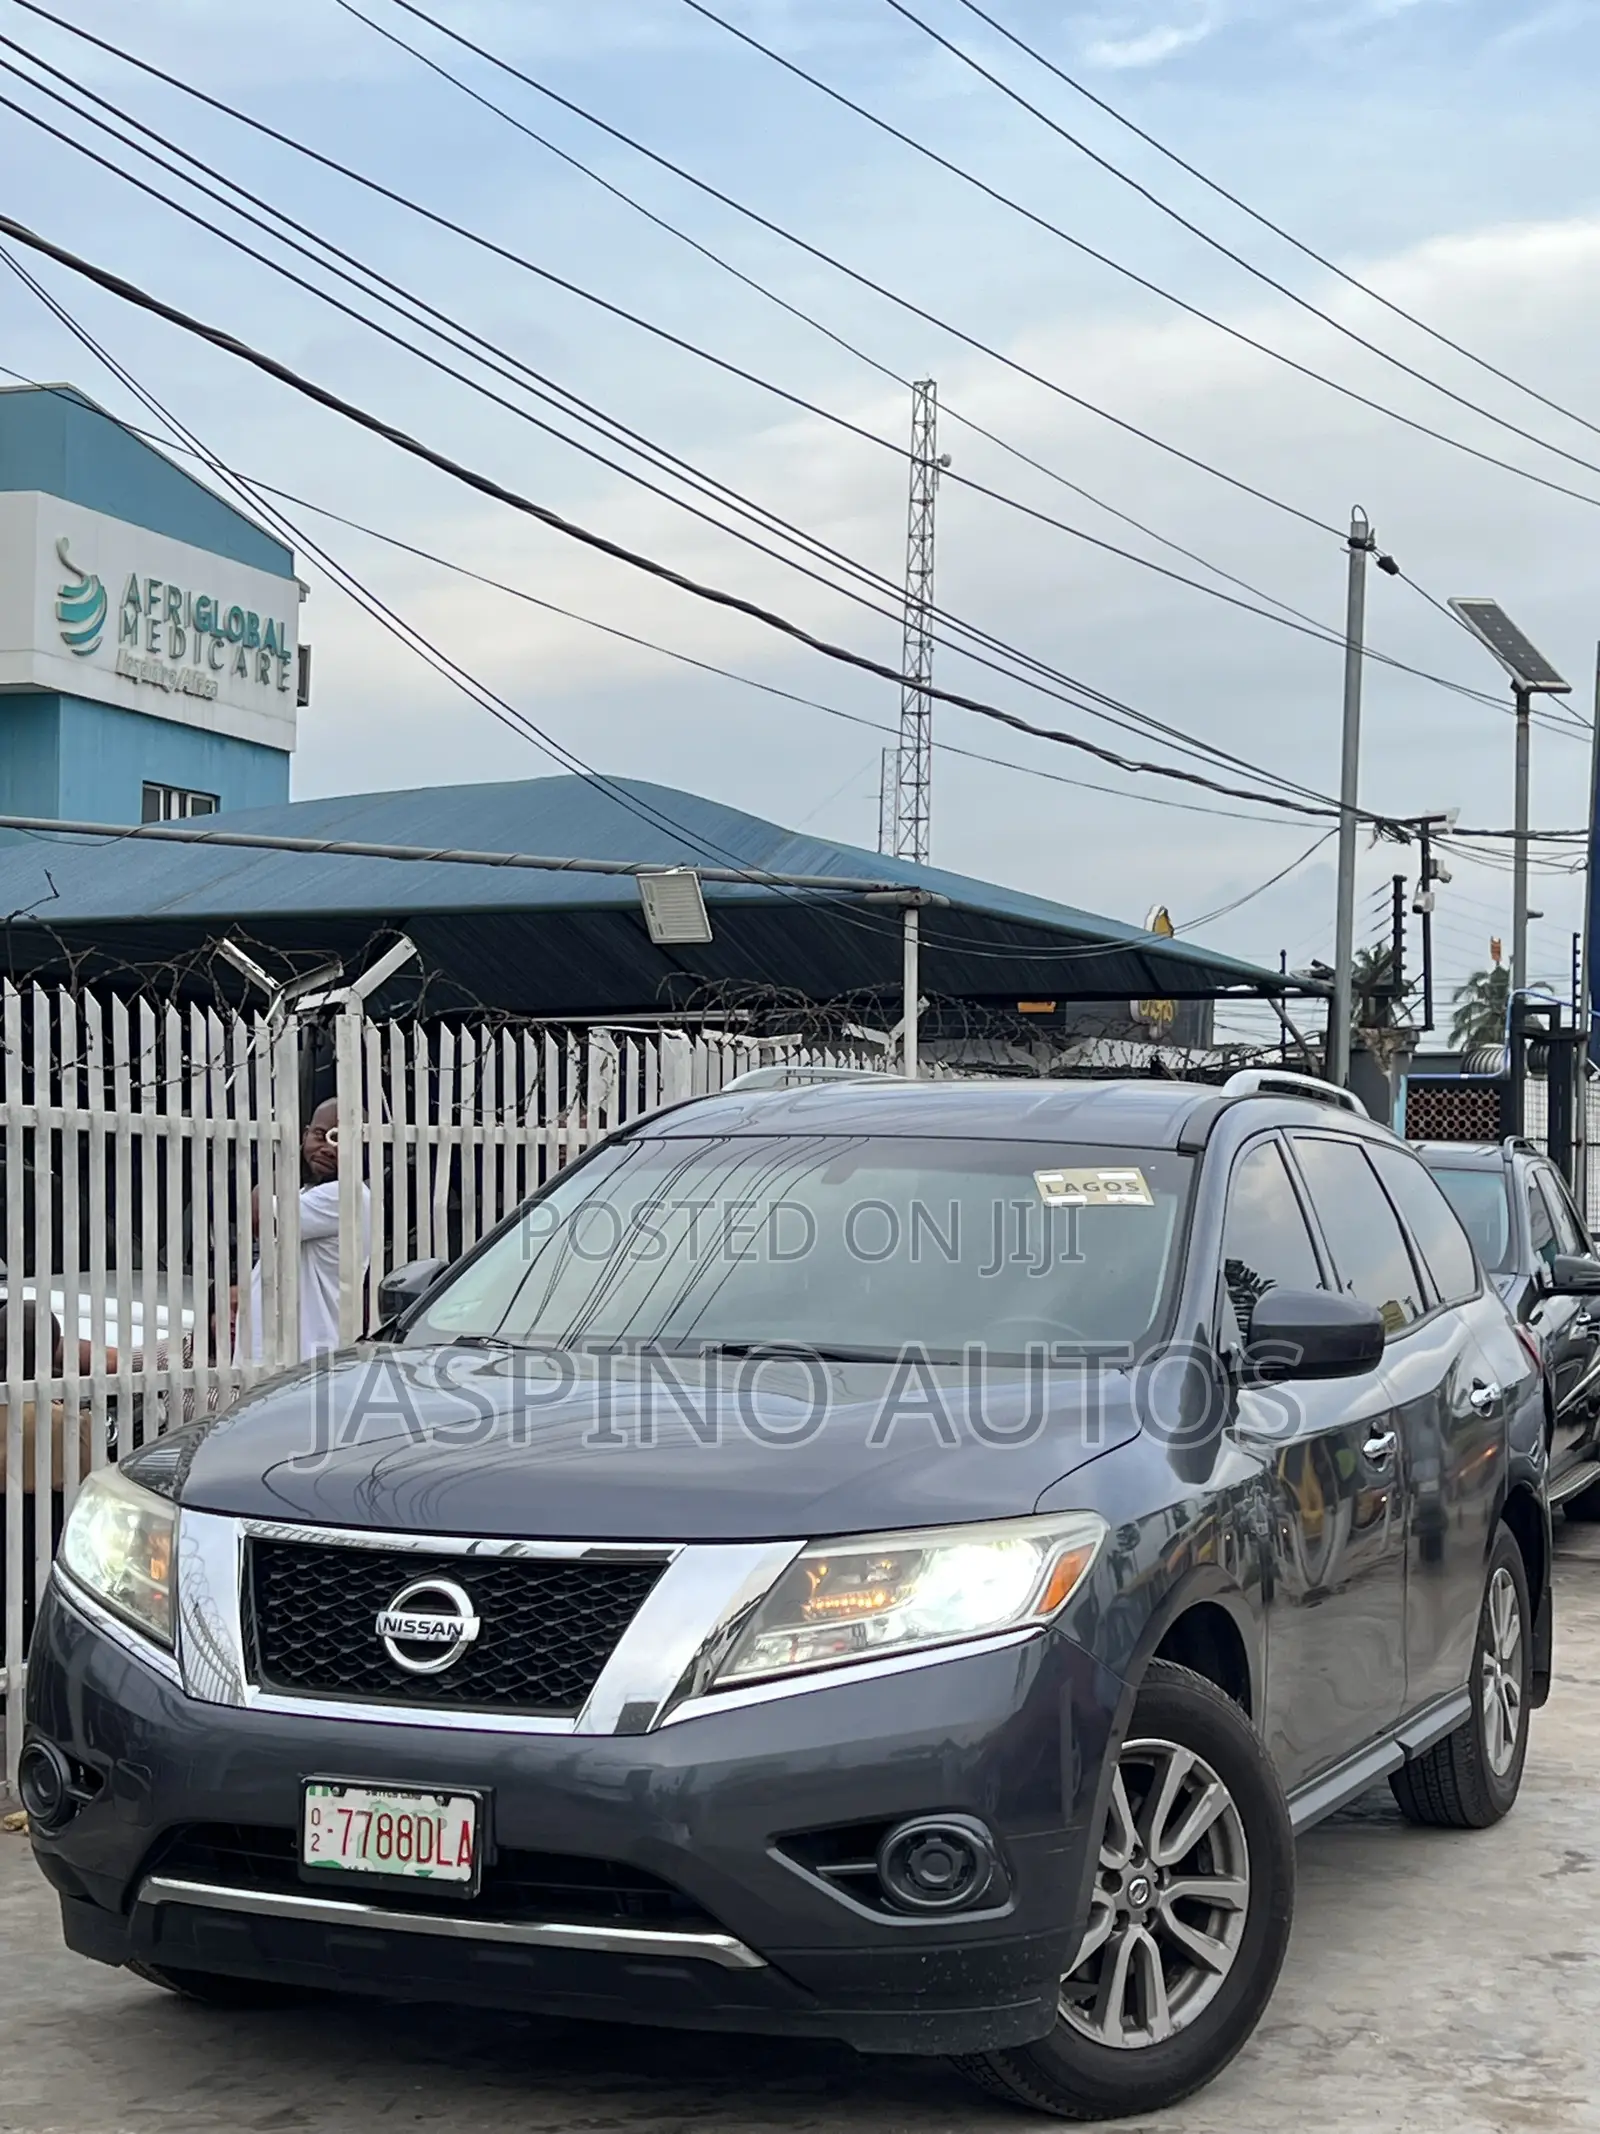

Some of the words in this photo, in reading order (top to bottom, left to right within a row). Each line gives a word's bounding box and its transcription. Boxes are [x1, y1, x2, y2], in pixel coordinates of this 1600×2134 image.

[120, 572, 292, 660] AFRIGLOBAL
[118, 606, 291, 692] MEDICARE
[1045, 1181, 1140, 1194] LAGOS
[382, 1616, 465, 1636] NISSAN
